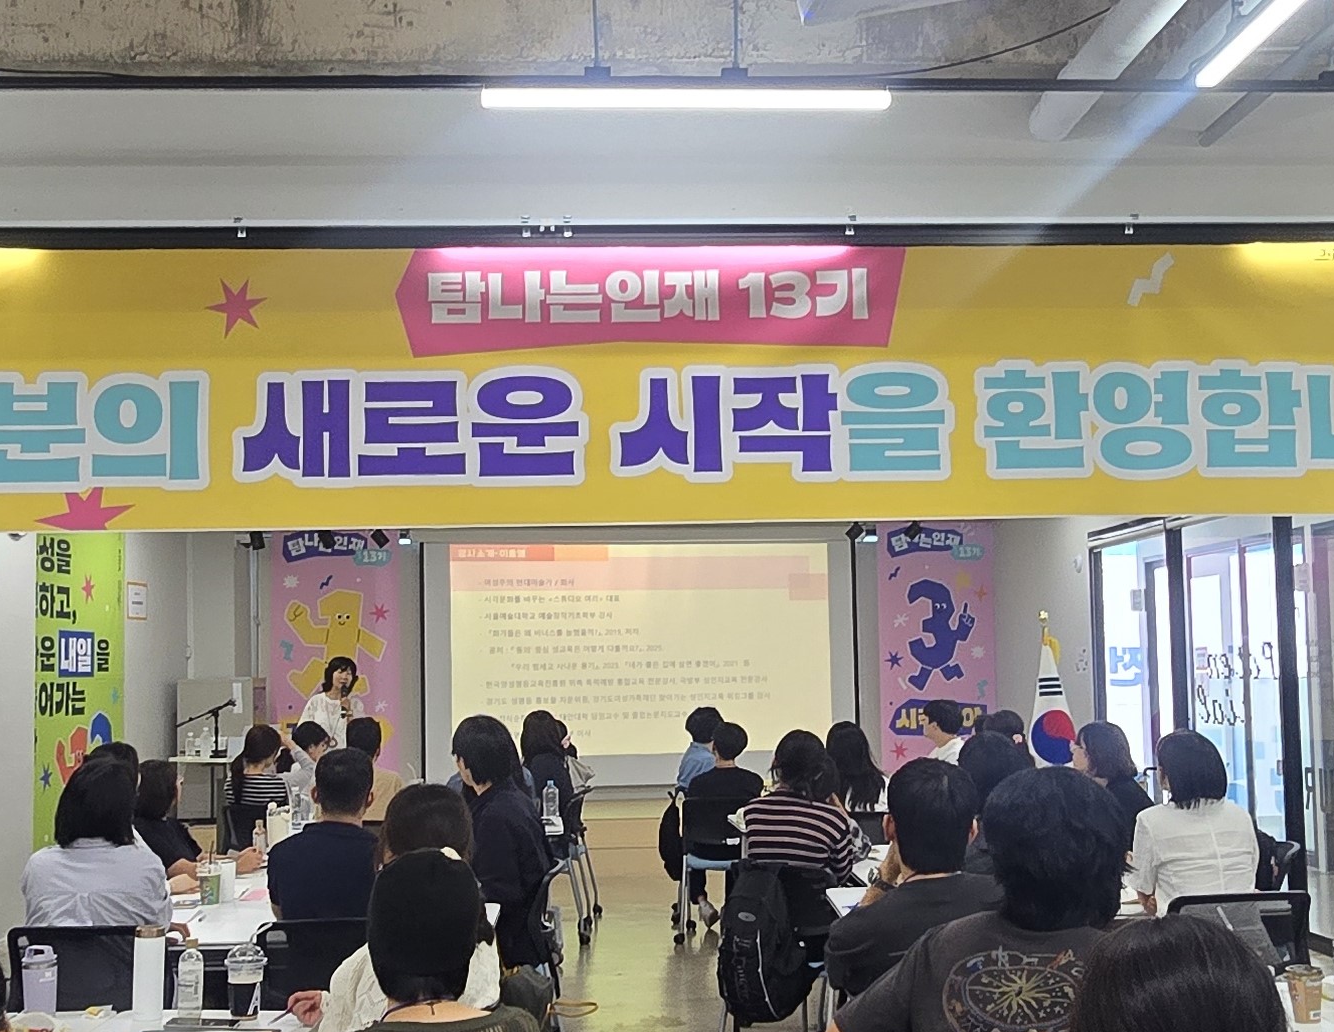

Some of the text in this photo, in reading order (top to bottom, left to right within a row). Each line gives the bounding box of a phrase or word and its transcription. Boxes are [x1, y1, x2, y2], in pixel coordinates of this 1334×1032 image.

[425, 266, 870, 326] 탐나는인재 13기
[239, 373, 583, 480] 새로운
[616, 370, 947, 476] 시작을
[35, 581, 77, 625] 하고,
[35, 635, 56, 673] 운
[34, 681, 86, 717] 어가는
